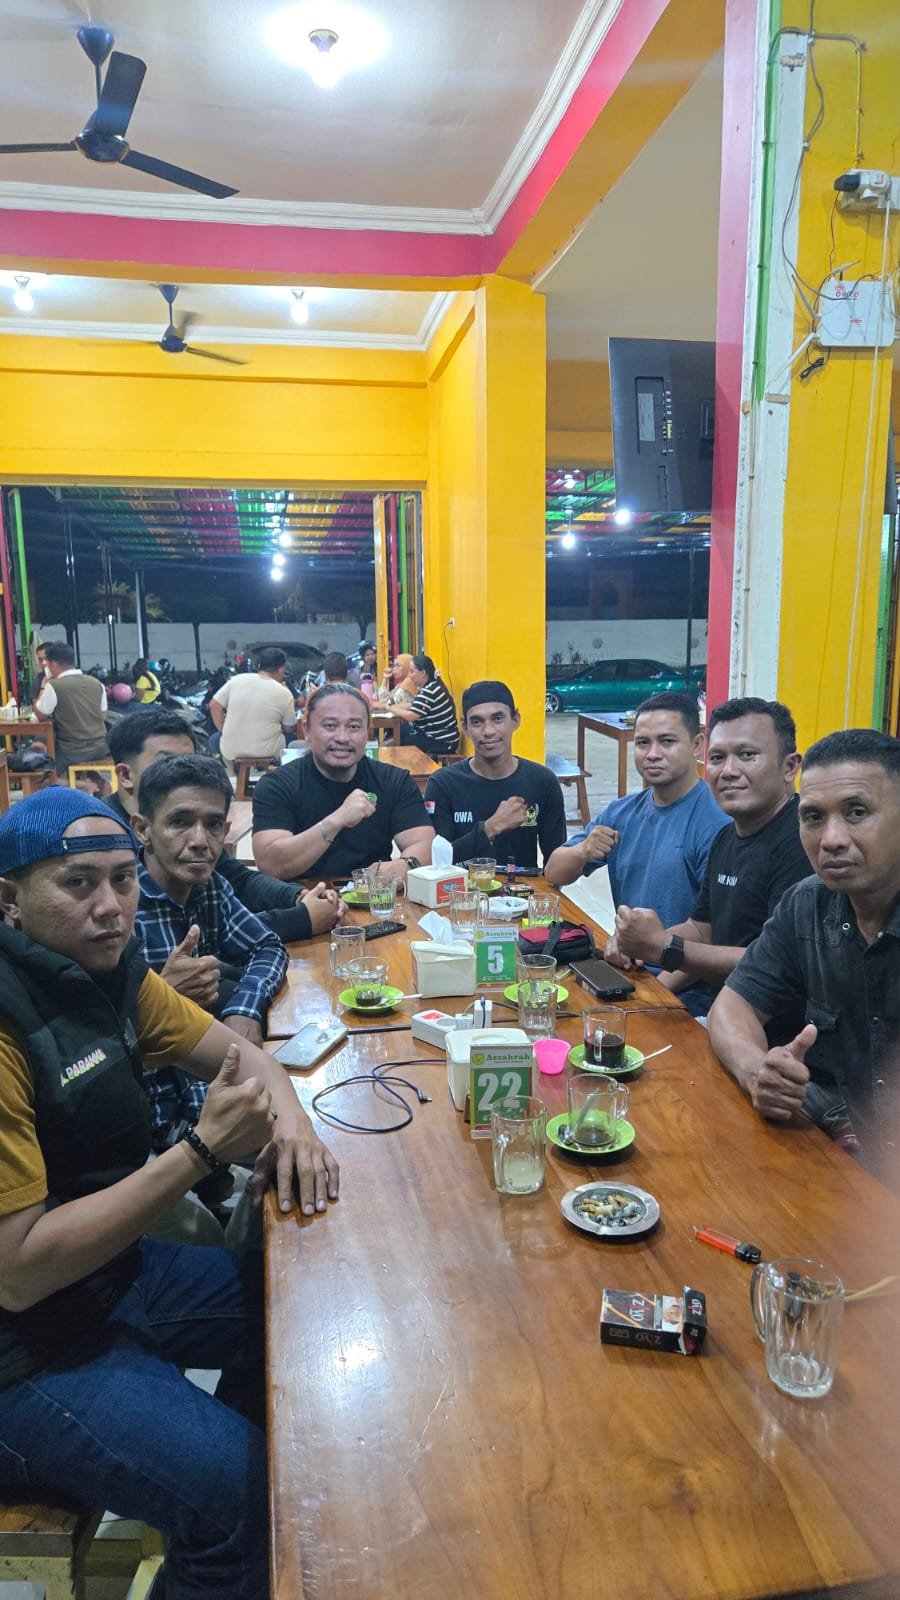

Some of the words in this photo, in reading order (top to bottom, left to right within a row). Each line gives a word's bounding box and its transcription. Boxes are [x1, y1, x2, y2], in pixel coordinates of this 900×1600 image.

[454, 811, 473, 823] OWA
[487, 945, 504, 974] 5
[487, 1053, 530, 1061] Azzahrah
[477, 1071, 522, 1111] 22
